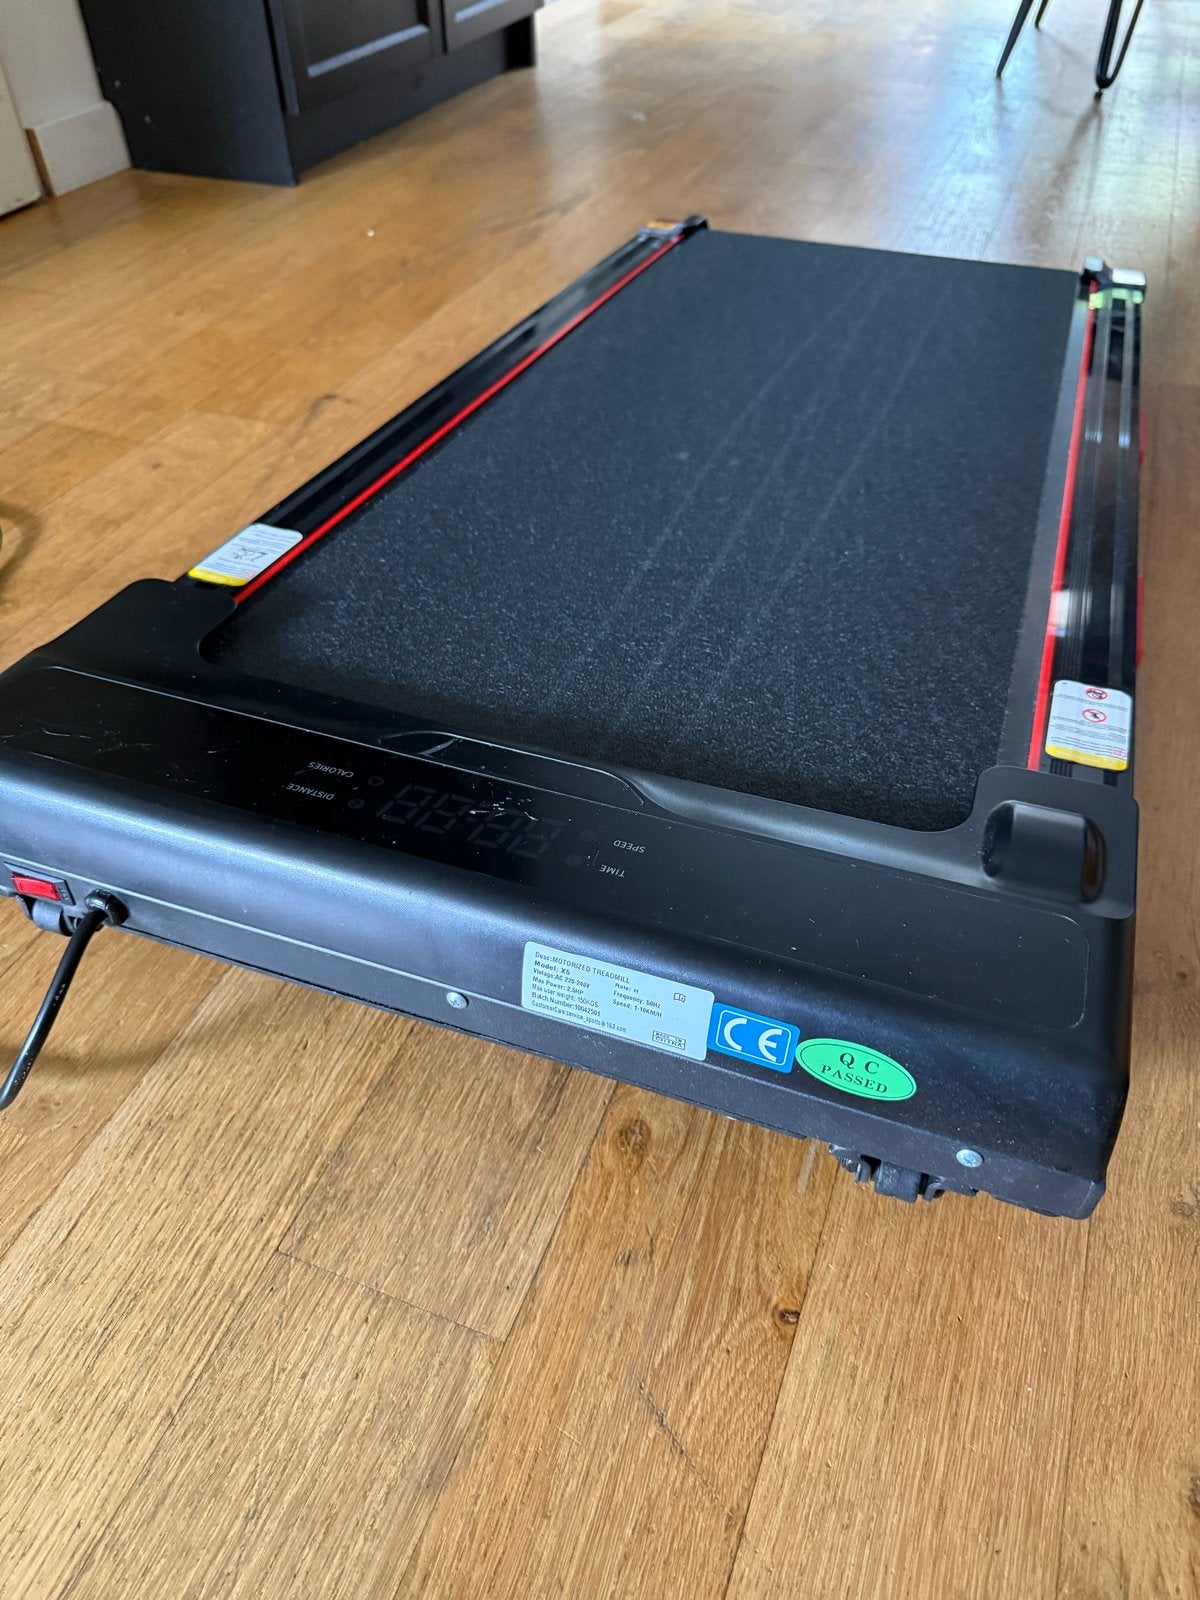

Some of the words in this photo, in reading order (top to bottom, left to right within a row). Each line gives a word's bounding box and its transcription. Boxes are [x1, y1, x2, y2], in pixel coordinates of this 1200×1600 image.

[308, 761, 354, 778] CALORIES
[286, 782, 335, 801] DISTANCE
[613, 839, 646, 853] SPEED
[598, 864, 625, 878] TIME
[534, 960, 558, 972] Model:
[533, 976, 544, 984] Max
[546, 979, 565, 990] Power:
[592, 968, 630, 984] TREADMILL
[532, 984, 543, 992] Max
[544, 987, 555, 995] user
[532, 991, 549, 1002] Batch
[612, 999, 633, 1010] Speed:
[646, 1000, 661, 1008] 50Hz
[724, 1018, 782, 1062] CE
[840, 1053, 855, 1069] Q
[864, 1061, 879, 1074] C
[821, 1064, 888, 1094] PASSED
